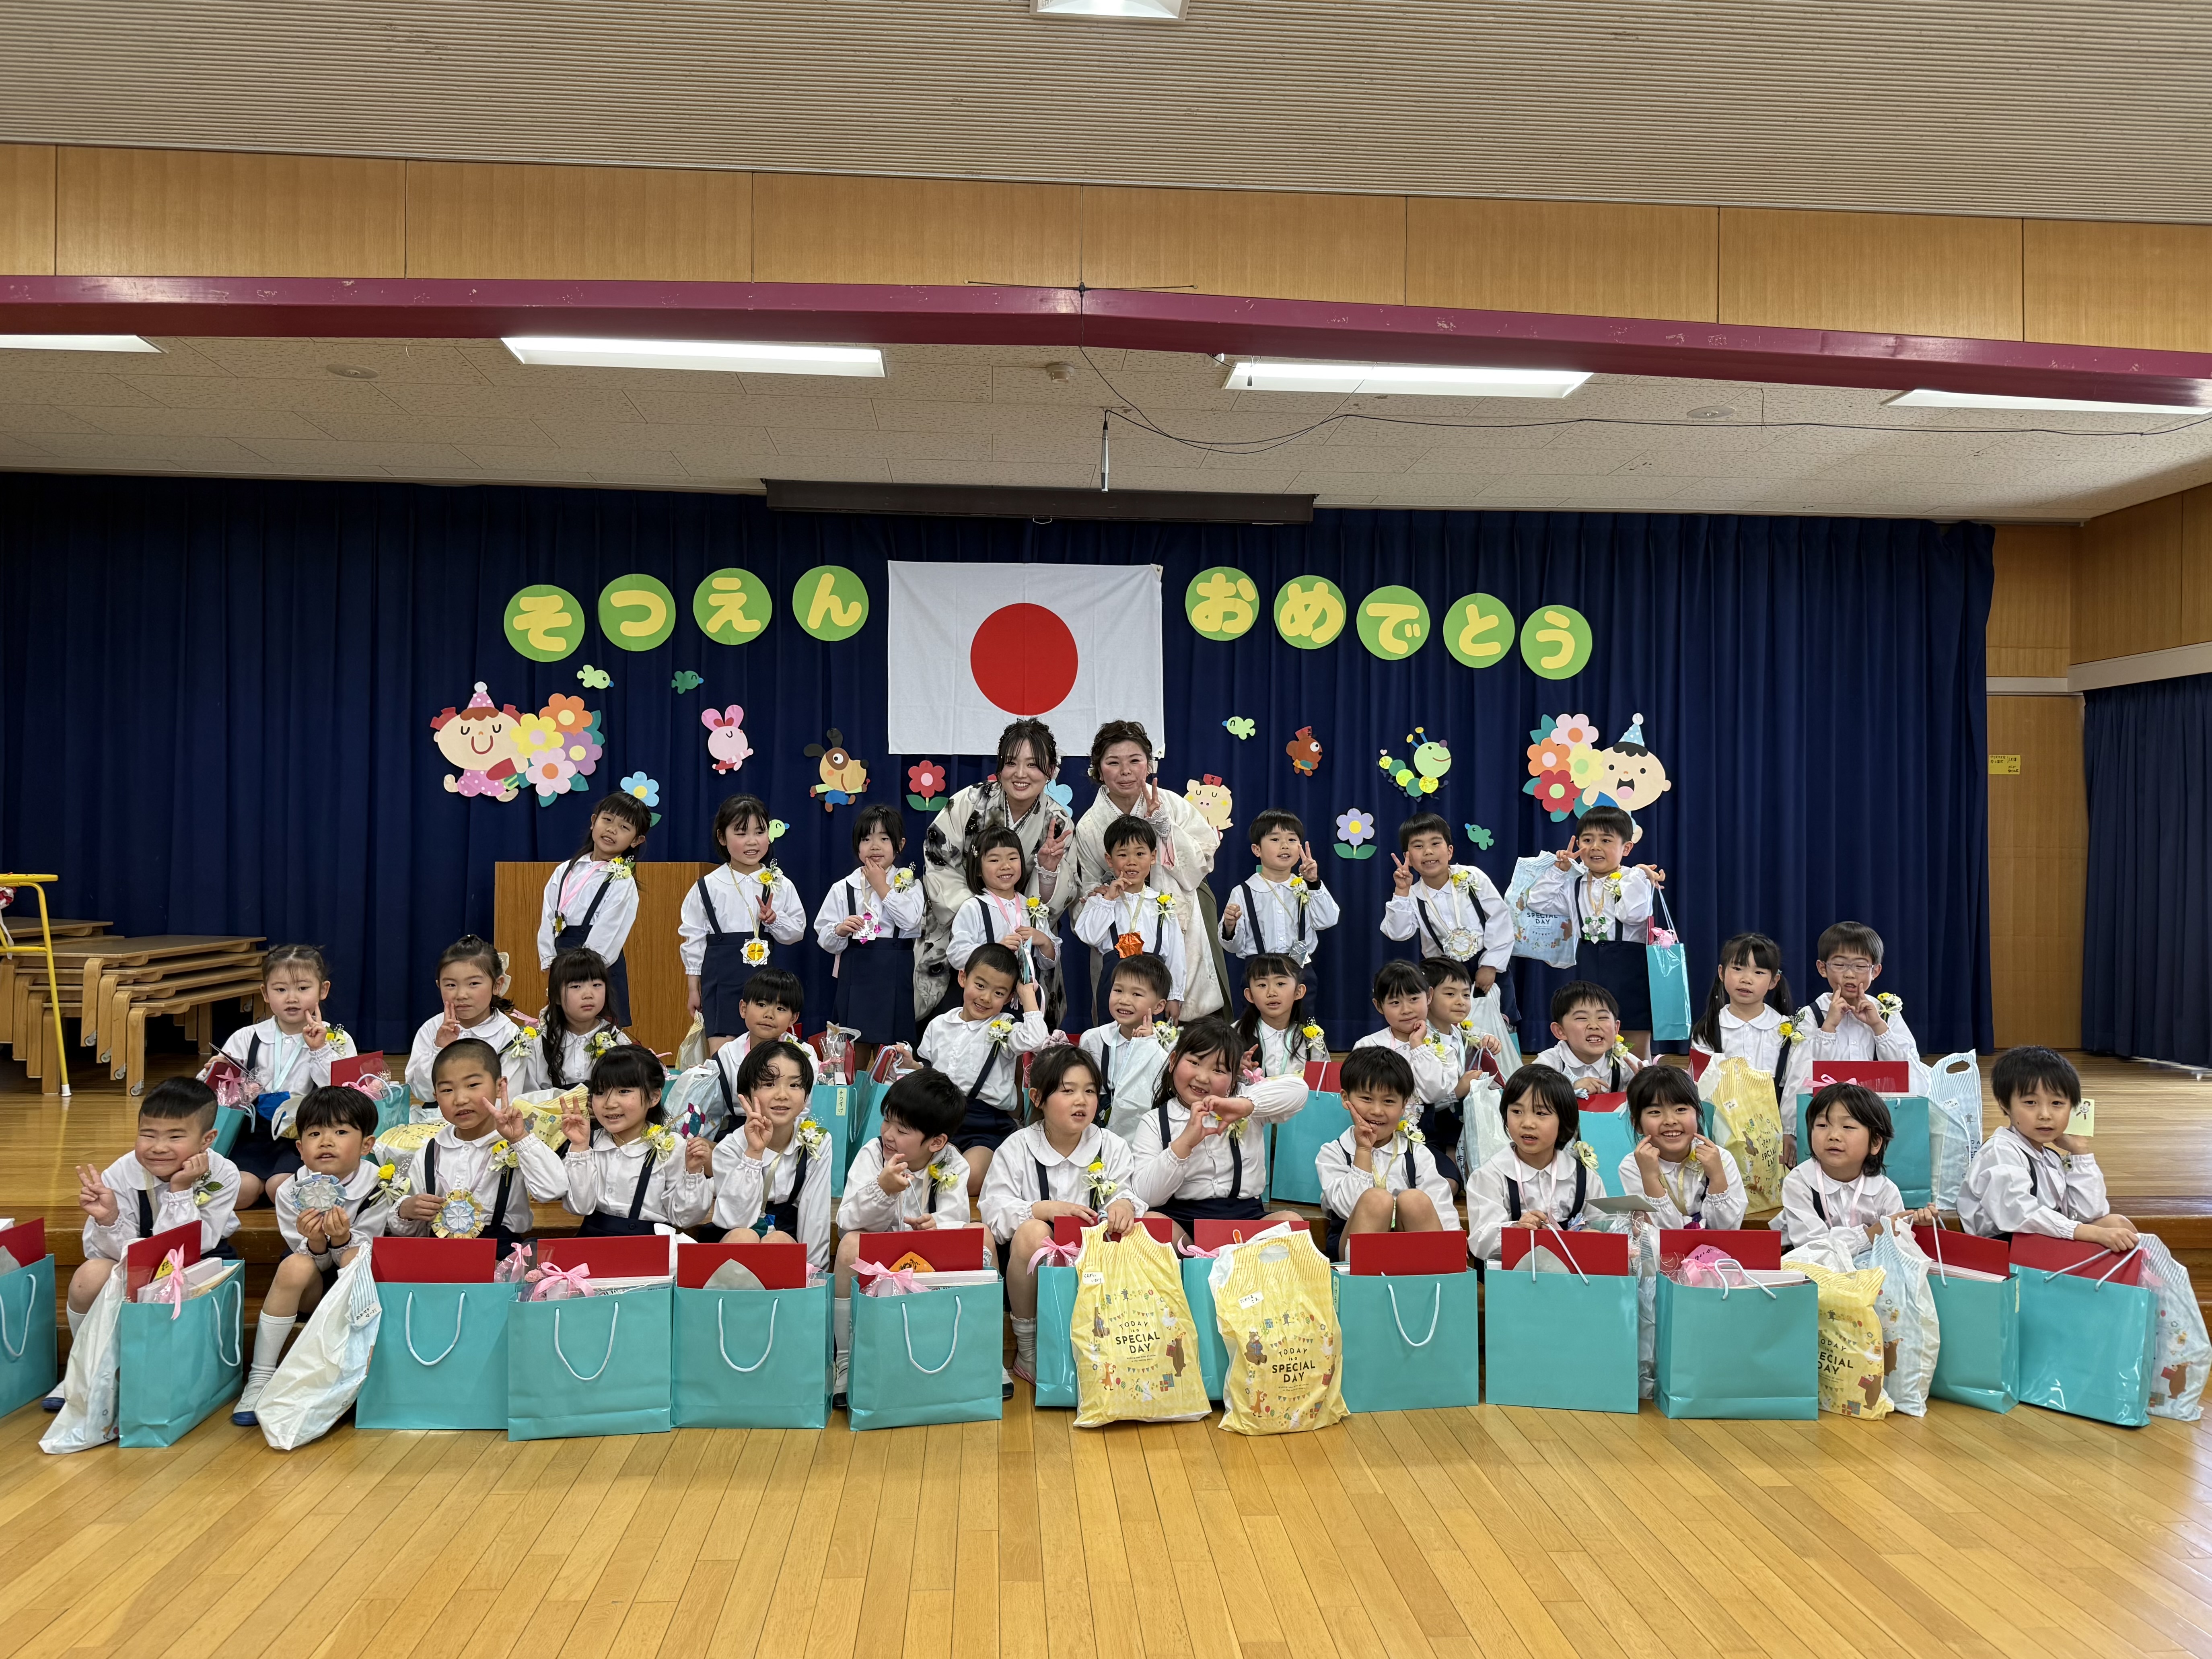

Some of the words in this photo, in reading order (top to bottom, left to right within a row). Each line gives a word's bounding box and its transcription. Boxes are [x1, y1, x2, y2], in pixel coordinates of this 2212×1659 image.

[513, 573, 862, 652] そつえん
[1191, 573, 1575, 669] おめでとう
[1119, 1321, 1148, 1330] TODAY
[1115, 1332, 1160, 1345] SPECIAL
[1129, 1343, 1150, 1354] DAY
[1821, 1339, 1846, 1351] ODAY
[1278, 1348, 1307, 1357] TODAY
[1819, 1351, 1854, 1369] ECIAL
[1272, 1360, 1315, 1373] SPECIAL
[1284, 1372, 1304, 1383] DAY
